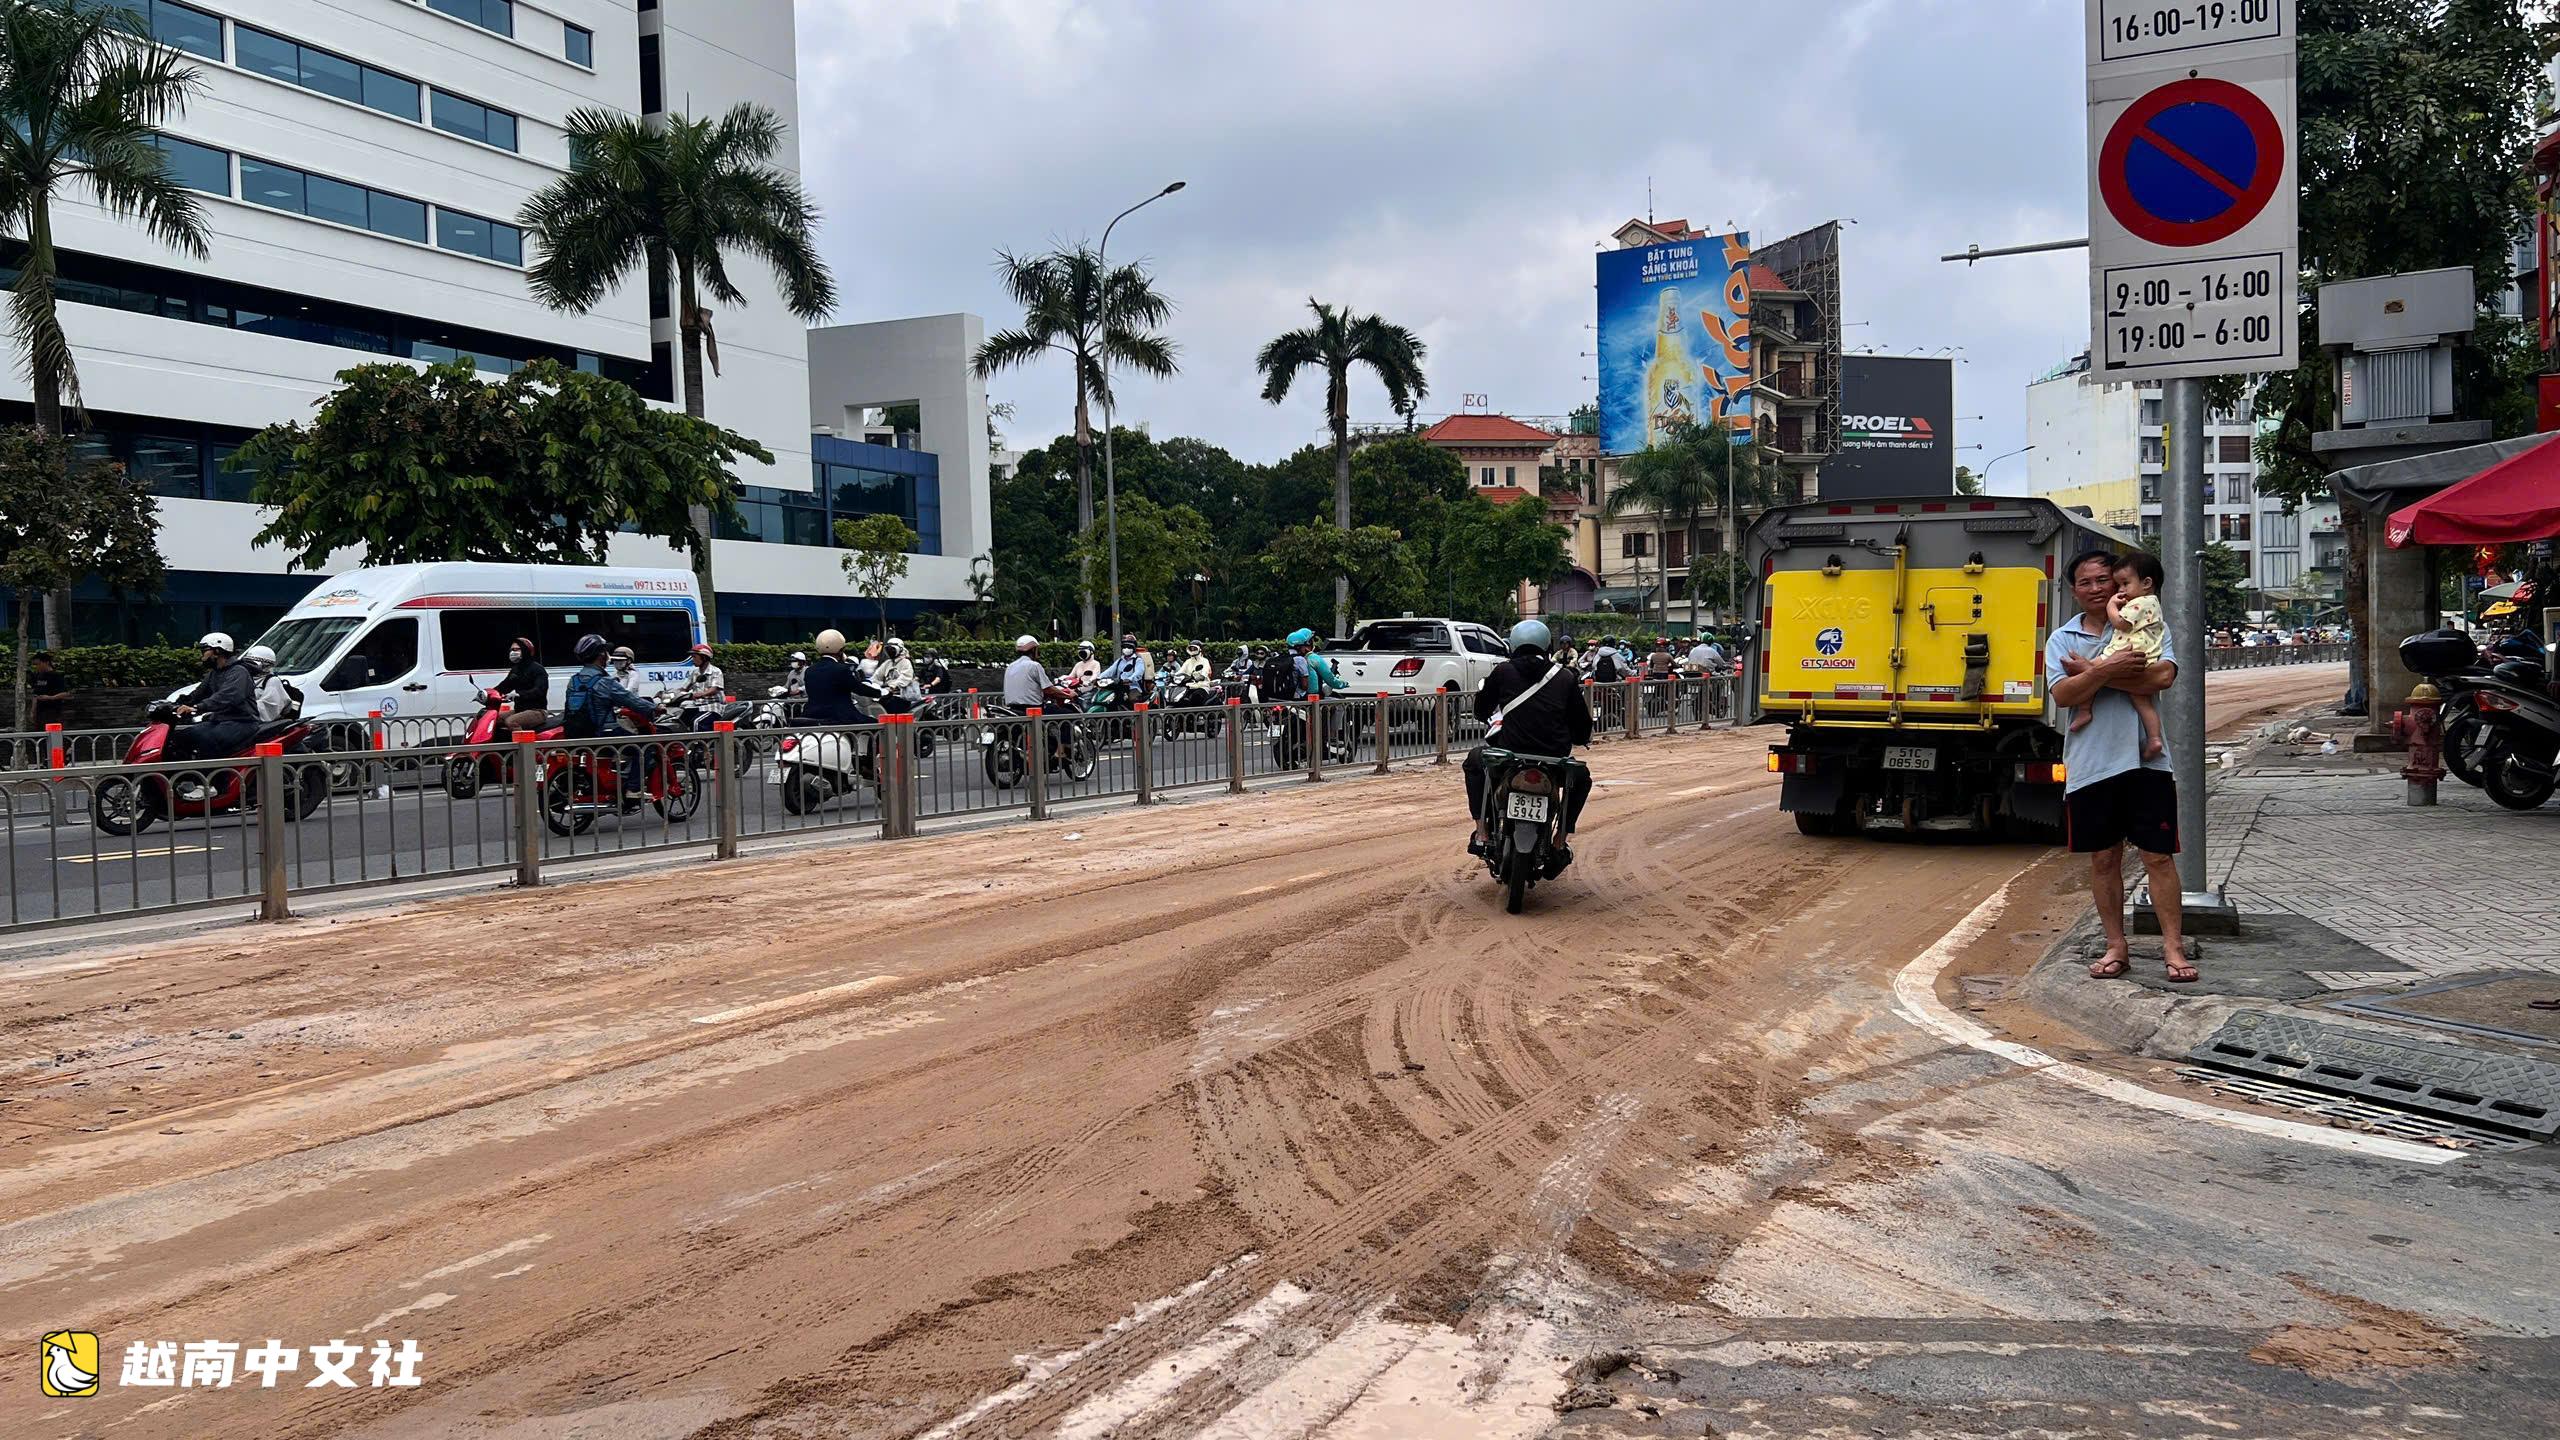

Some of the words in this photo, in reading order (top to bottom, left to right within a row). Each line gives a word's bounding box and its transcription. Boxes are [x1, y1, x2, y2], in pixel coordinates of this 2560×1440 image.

[2112, 0, 2268, 43] 16:00-19:00
[1668, 247, 1693, 259] TUNG
[1670, 258, 1698, 272] KHOÁI
[2116, 279, 2170, 310] 9:00
[2201, 270, 2270, 301] 16:00
[2118, 322, 2185, 353] 19:00
[2215, 315, 2270, 346] 6:00
[1841, 415, 1913, 431] PROEL
[1888, 441, 1907, 449] thanh
[634, 581, 654, 591] 0971
[656, 581, 668, 591] 52
[669, 581, 688, 592] 1313
[635, 599, 683, 607] LIMOUSINE
[1801, 659, 1856, 669] GTSAIGON
[1899, 748, 1922, 758] 51C
[1889, 757, 1930, 769] 085.90
[1512, 806, 1542, 819] 5944
